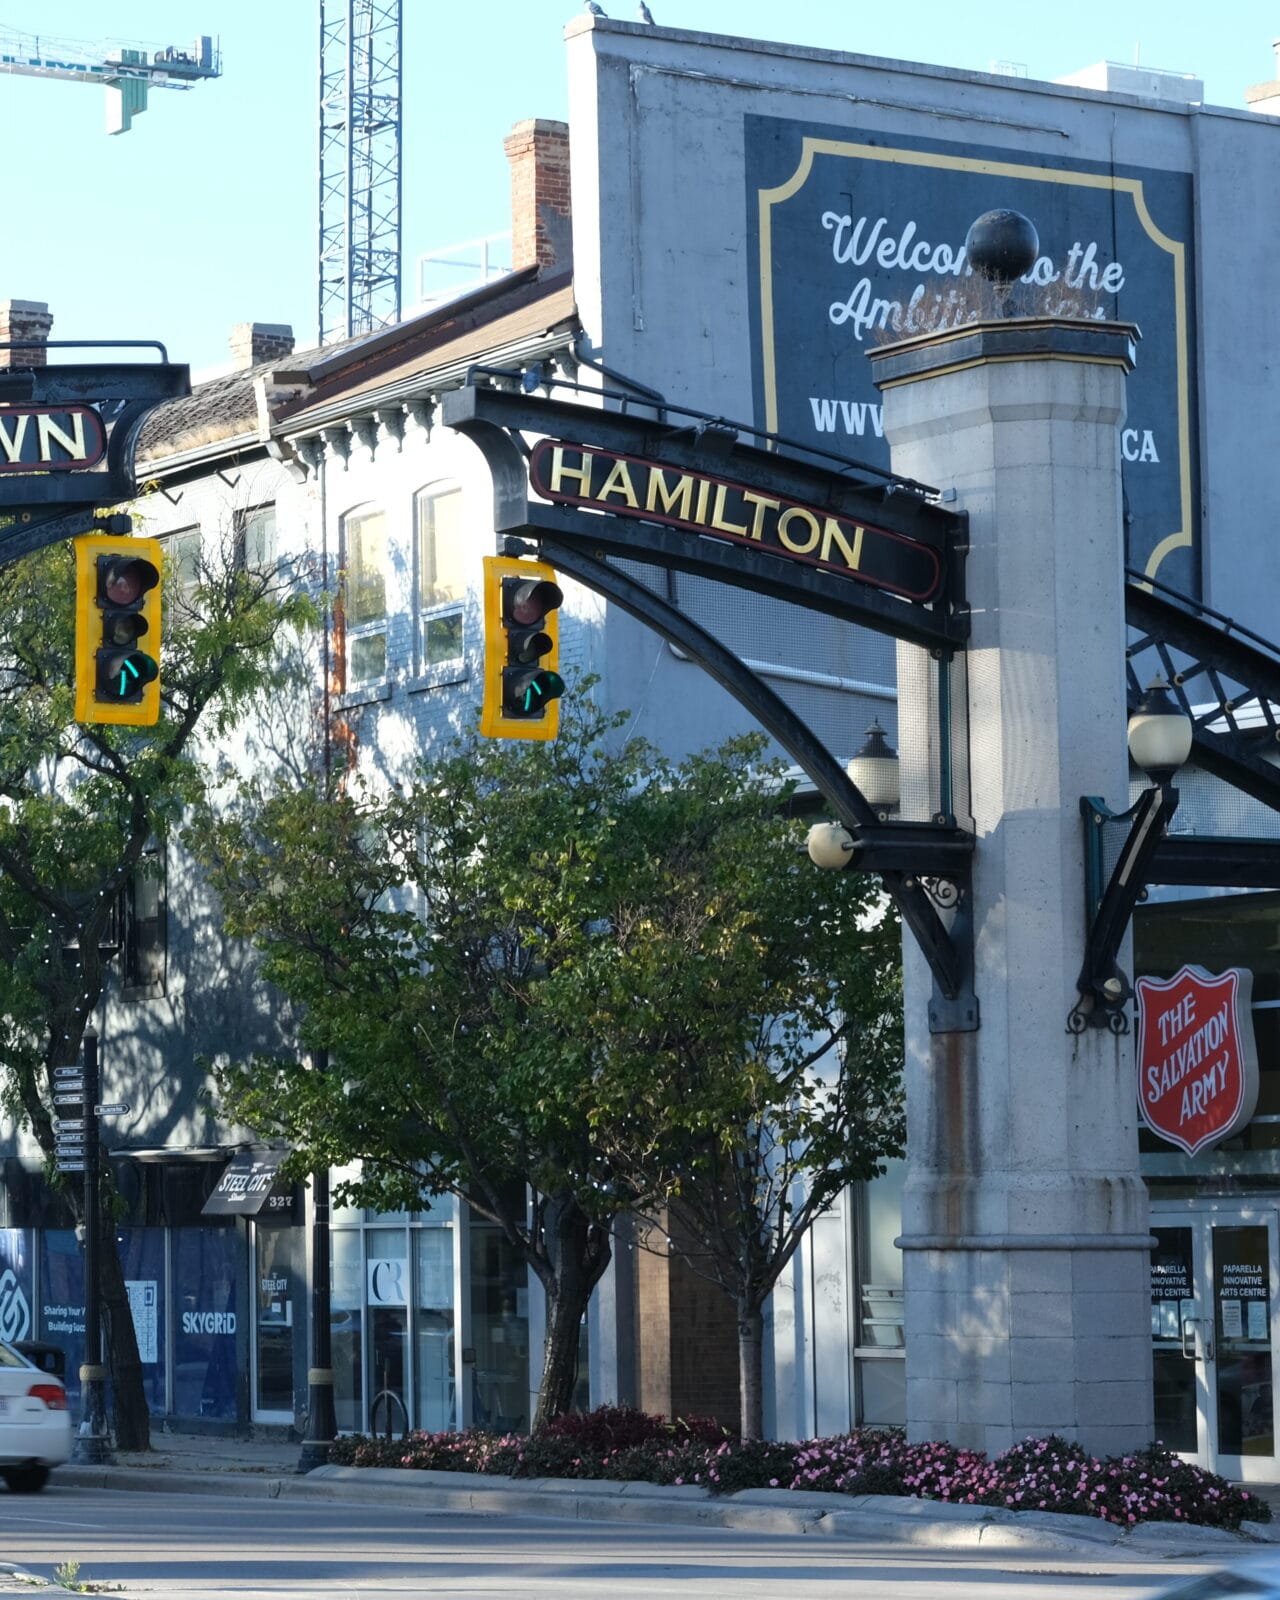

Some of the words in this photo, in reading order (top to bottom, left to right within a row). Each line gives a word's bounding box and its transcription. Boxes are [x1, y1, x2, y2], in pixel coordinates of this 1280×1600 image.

[1064, 241, 1126, 294] the
[549, 446, 865, 571] HAMILTON
[1158, 991, 1197, 1048] THE
[1147, 1001, 1230, 1104] SALVATION
[1179, 1050, 1231, 1127] ARMY
[218, 1173, 251, 1192] STEEL
[269, 1196, 294, 1208] 327
[1222, 1264, 1263, 1274] PAPARELLA
[1151, 1276, 1187, 1286] NNOVATIVE
[1222, 1276, 1263, 1286] INNOVATIVE
[1151, 1288, 1164, 1297] RTS
[1164, 1288, 1191, 1297] CENTRE
[1220, 1288, 1238, 1297] ARTS
[1239, 1288, 1267, 1297] CENTRE
